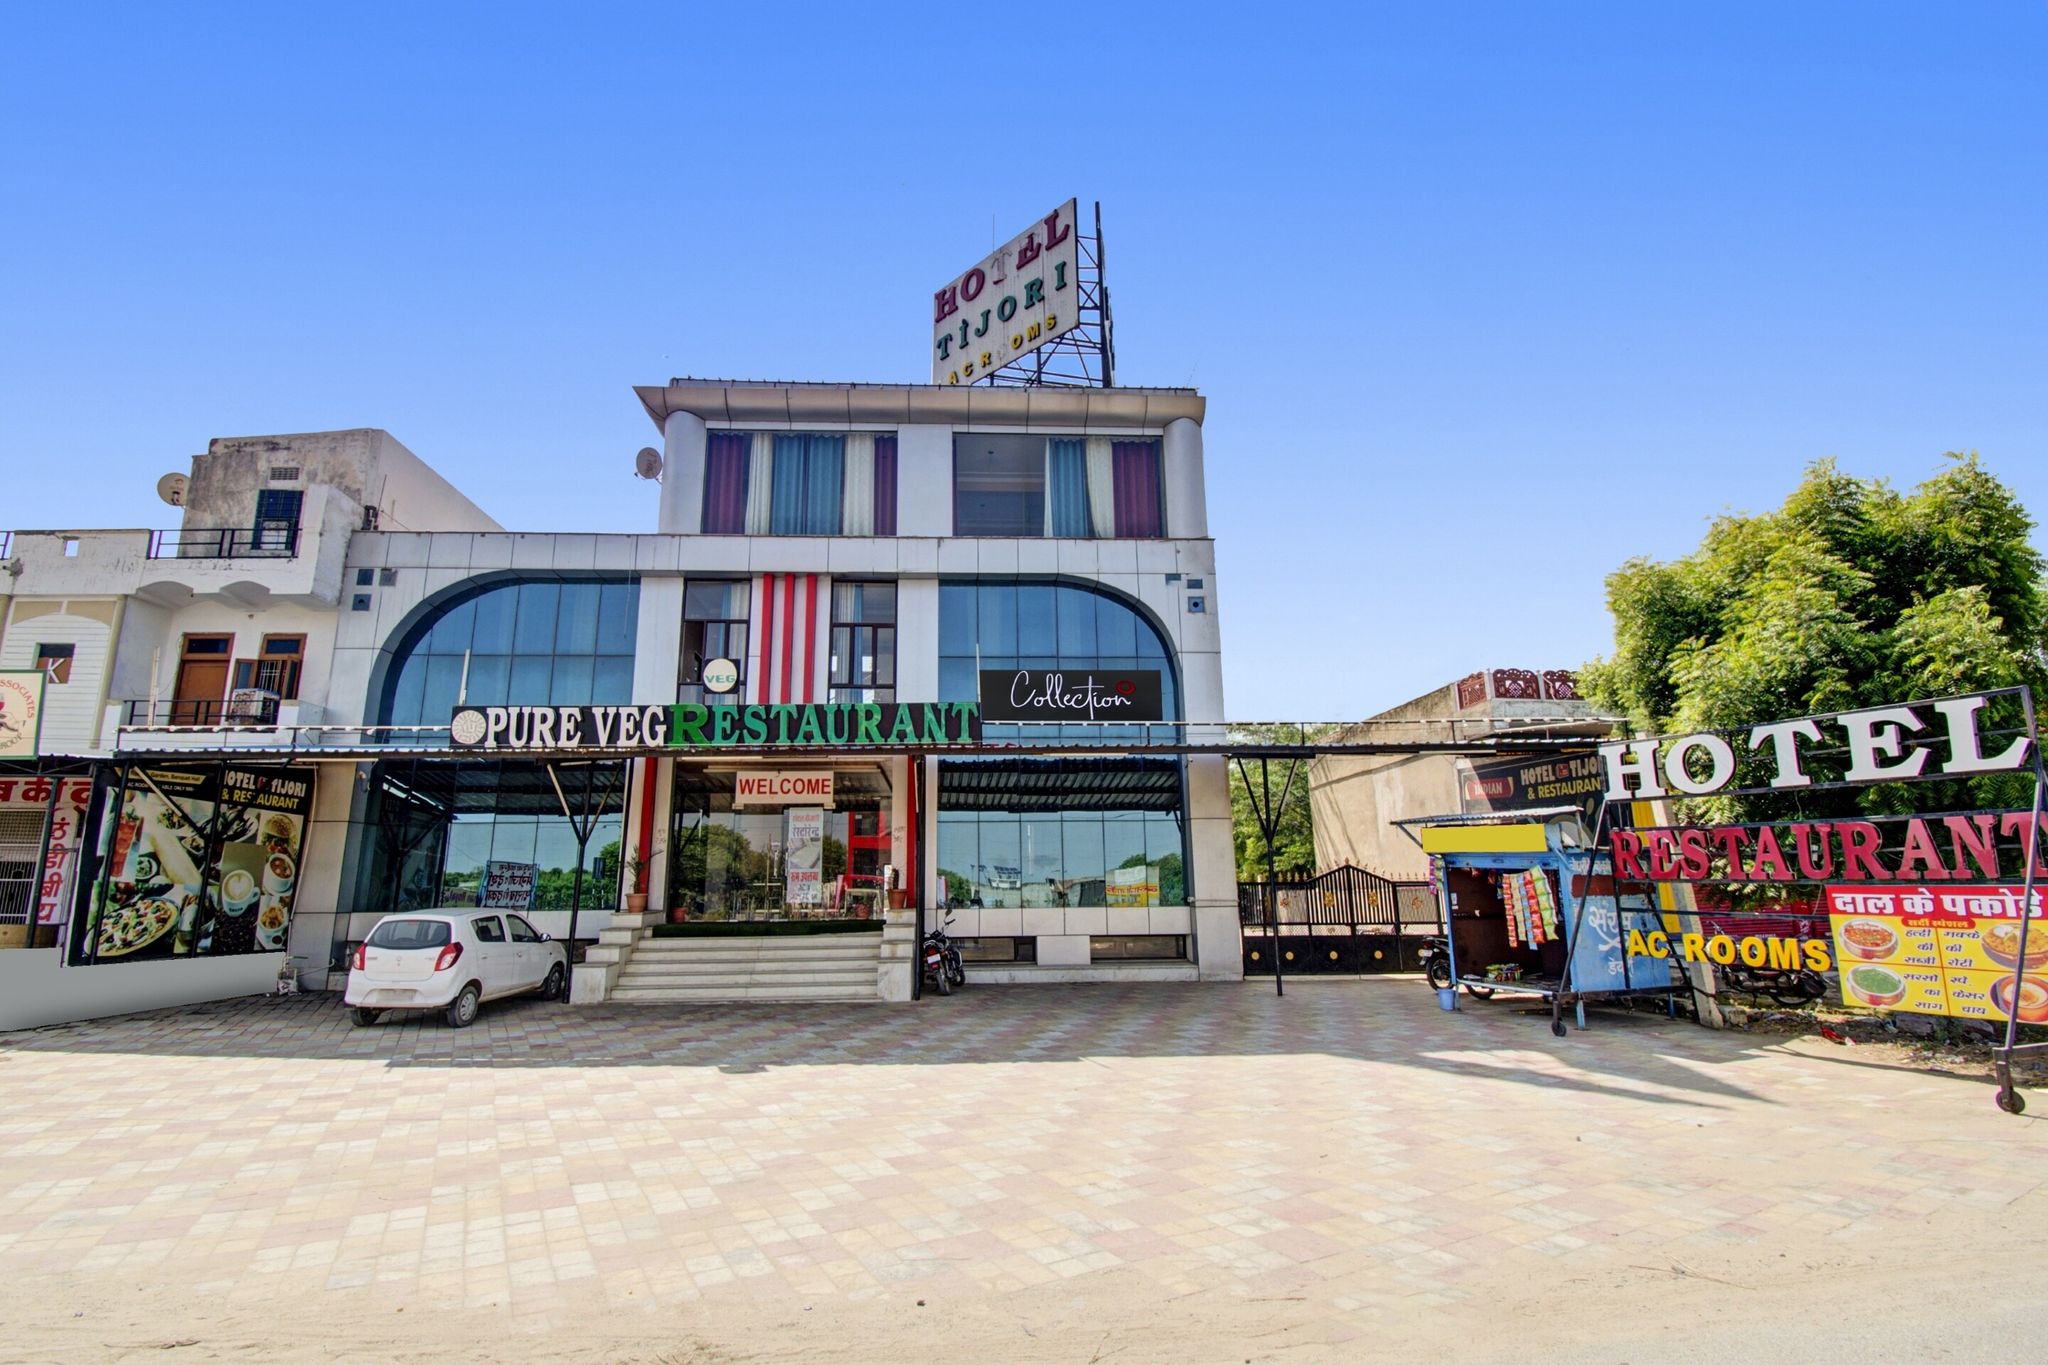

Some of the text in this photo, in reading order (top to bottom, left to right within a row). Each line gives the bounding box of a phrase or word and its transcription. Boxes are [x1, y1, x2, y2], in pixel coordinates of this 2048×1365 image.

[934, 209, 1071, 323] HOTEL
[936, 261, 1067, 360] TIJORI
[705, 674, 737, 685] VEG
[1010, 670, 1132, 720] Collection
[484, 703, 980, 749] PURE VEG RESTAURANT
[1600, 697, 2034, 800] HOTEL
[1520, 755, 1600, 786] HOTEL TIJO
[739, 778, 831, 795] WELCOME
[1474, 781, 1503, 796] INDIAN
[1527, 776, 1601, 800] & RESTAURAN
[221, 789, 299, 809] & RESAURANT
[1609, 811, 2048, 881] RESTAURANT
[1832, 893, 1896, 914] दाल
[1900, 887, 1935, 915] के
[1905, 928, 1932, 938] हल्दी
[1943, 930, 1981, 940] मक्के
[1627, 928, 1832, 972] AC ROOMS
[1917, 942, 1934, 952] की
[1945, 943, 1963, 953] की
[1904, 956, 1936, 966] सब्जी
[1948, 957, 1973, 968] रोटी
[1924, 987, 1941, 997] का
[1952, 989, 1986, 1000] केसर
[1915, 1001, 1943, 1011] साग
[1962, 1005, 1987, 1015] चाय
